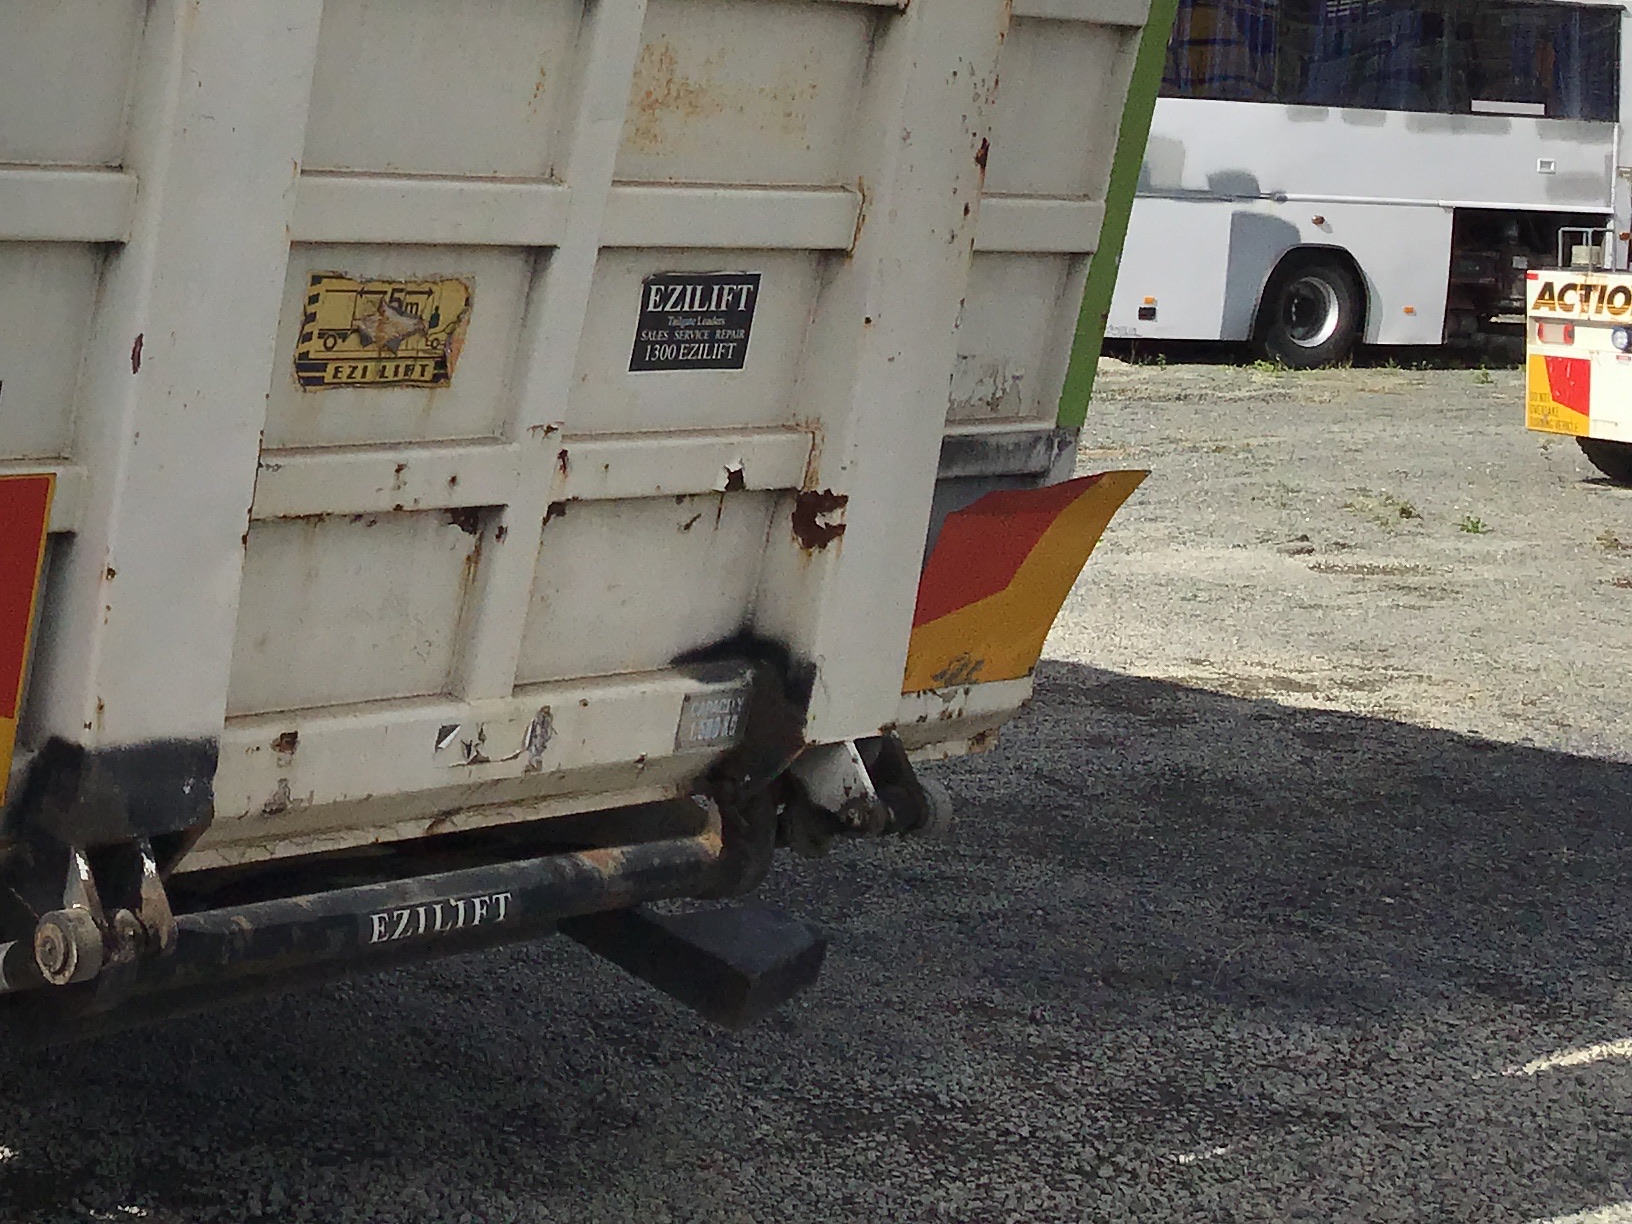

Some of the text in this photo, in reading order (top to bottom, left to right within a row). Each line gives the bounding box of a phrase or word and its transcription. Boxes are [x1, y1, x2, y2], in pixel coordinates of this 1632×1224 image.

[647, 284, 754, 312] EZILIFT
[640, 329, 746, 341] SALES SERVICE REPAIR
[645, 342, 737, 361] 1300 EZILIFT
[332, 362, 429, 380] EZI LIFT
[369, 892, 513, 944] EZILIFT
